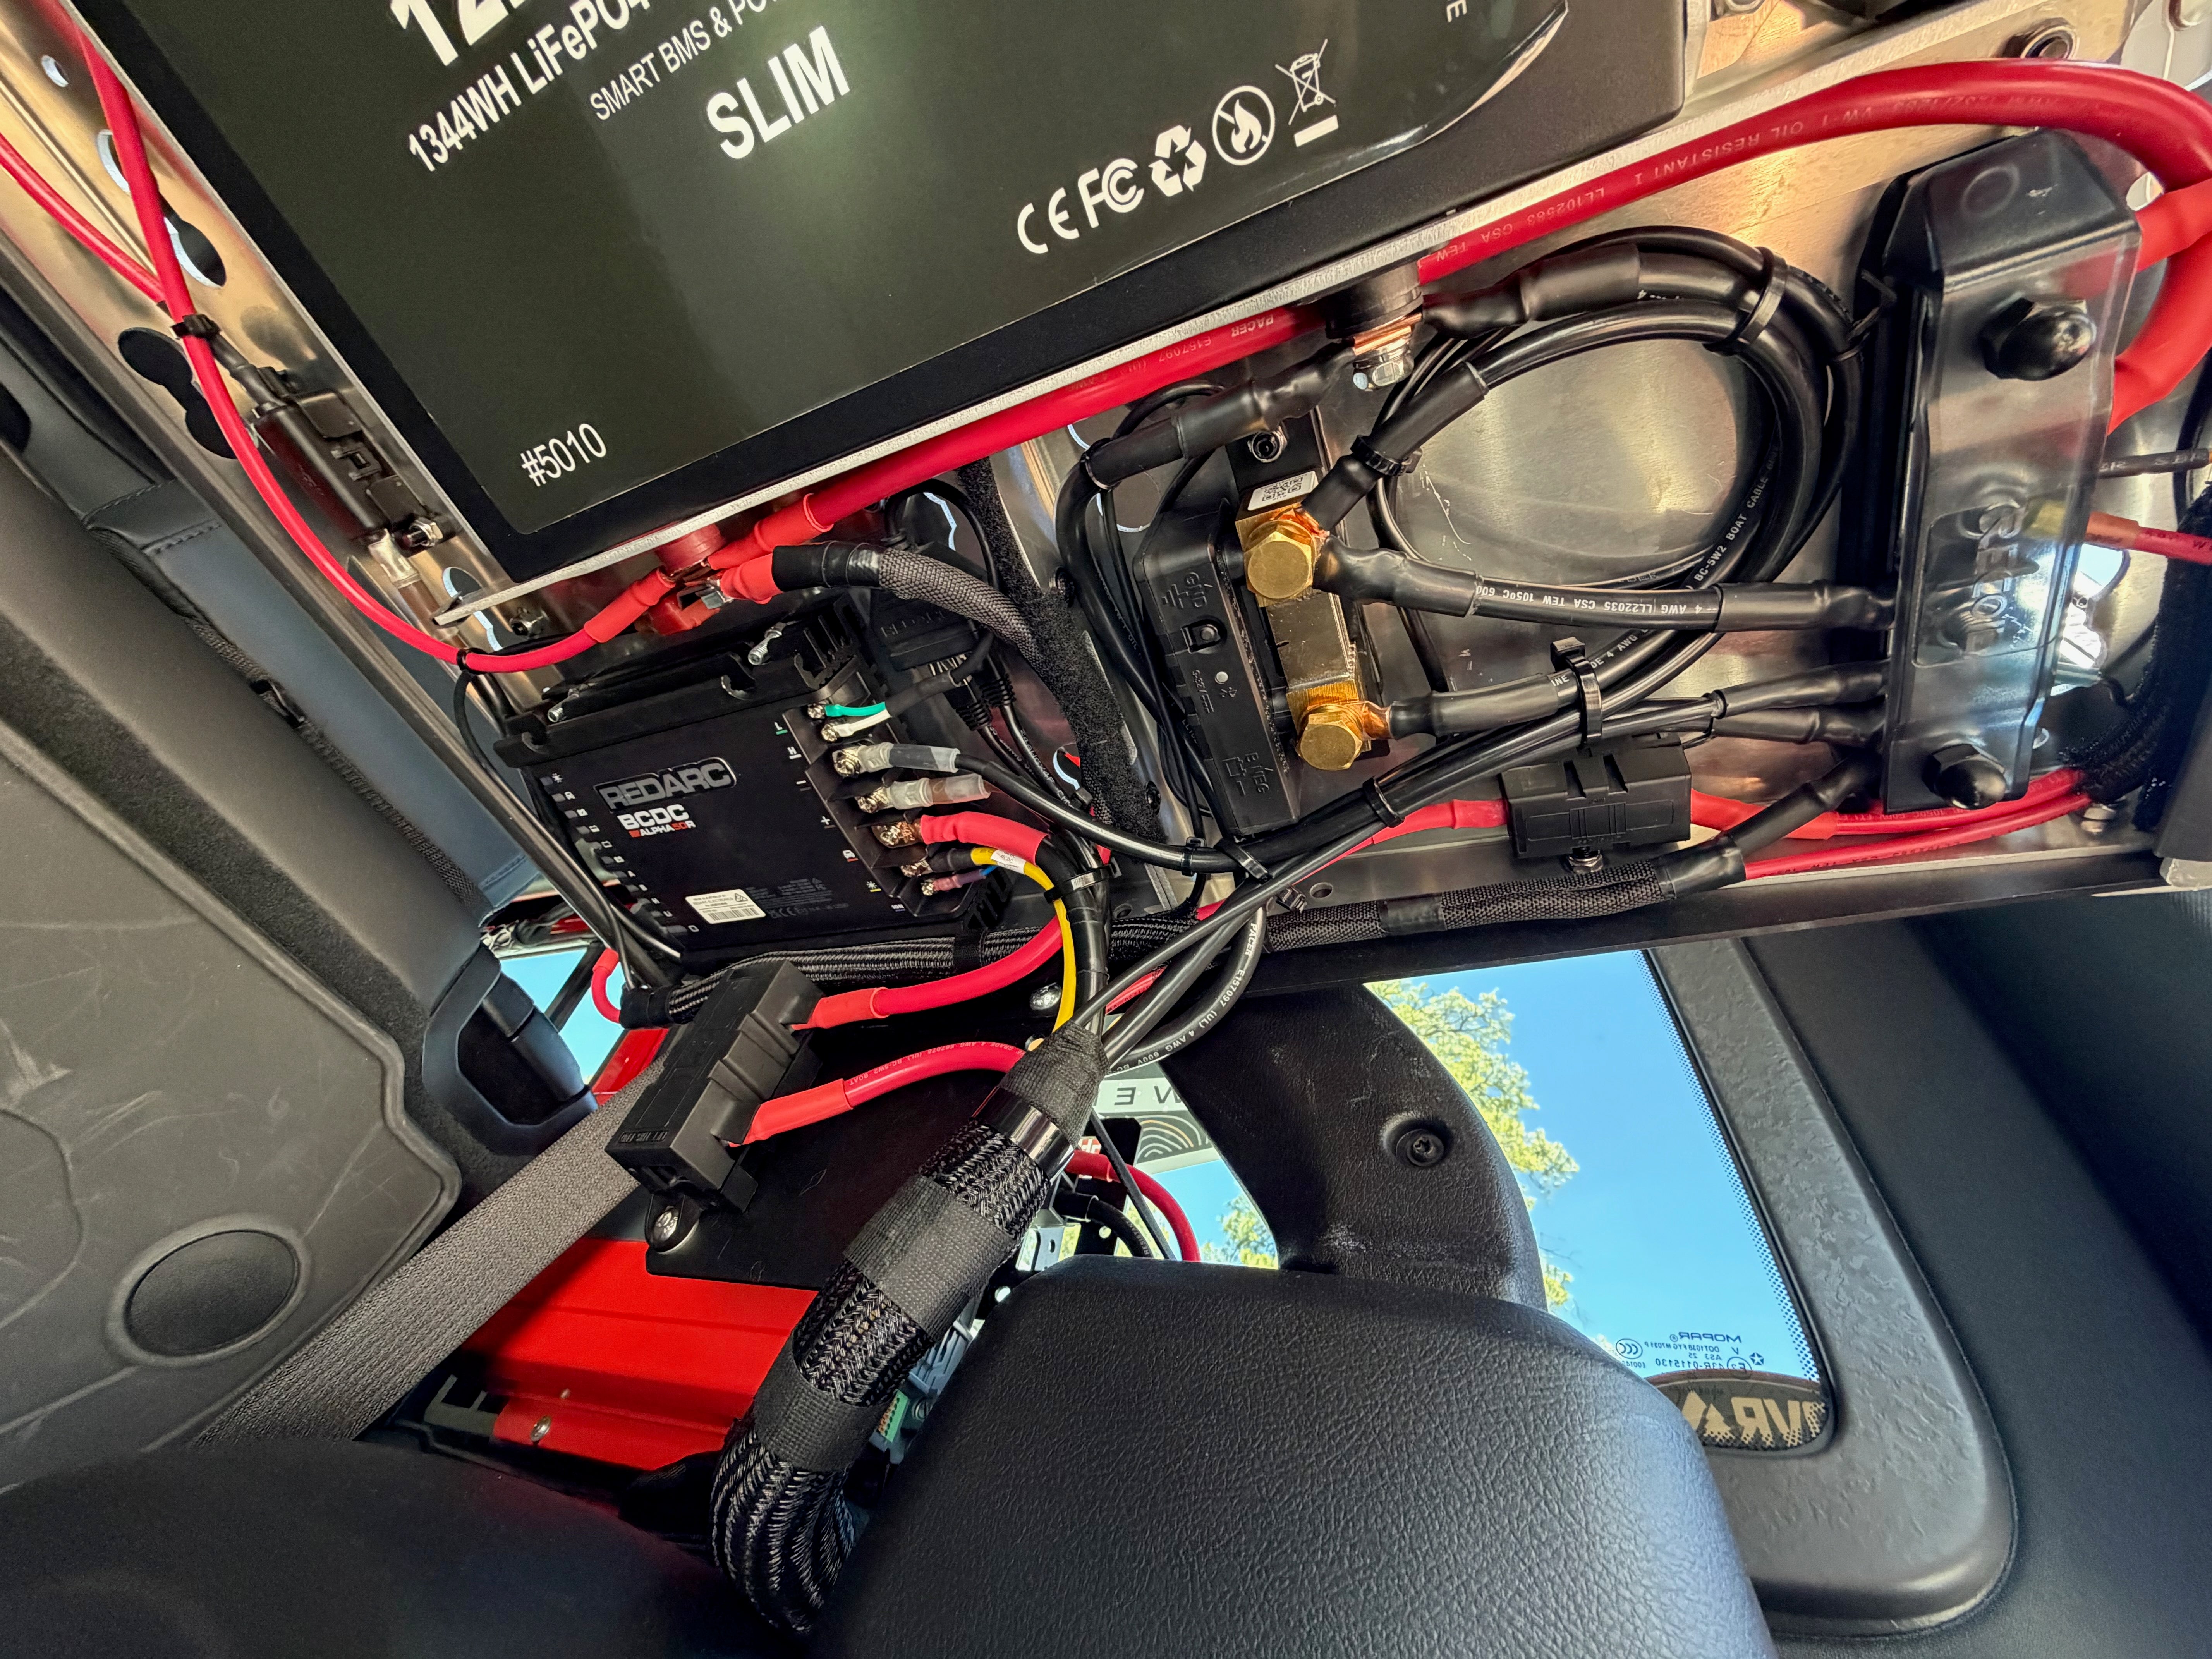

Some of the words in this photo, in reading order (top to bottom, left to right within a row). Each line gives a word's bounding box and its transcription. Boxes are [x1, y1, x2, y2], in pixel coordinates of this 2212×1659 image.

[589, 53, 661, 121] SMART
[658, 20, 711, 74] BMS
[710, 6, 732, 38] &
[706, 25, 851, 161] SLIM
[407, 65, 522, 172] 1344WH
[1770, 120, 1803, 141] OIL
[1653, 132, 1760, 181] RESISTANT
[1230, 314, 1274, 339] PACER
[1159, 335, 1212, 363] E157097
[520, 423, 607, 487] #5010
[1693, 544, 1727, 581] BC-5W2
[1726, 514, 1748, 541] BOAT
[1747, 475, 1769, 508] CABLE
[1542, 595, 1565, 607] TEW
[1574, 598, 1597, 610] CSA
[1604, 600, 1653, 615] LL22035
[1661, 603, 1686, 615] AWG
[1694, 603, 1703, 613] 4
[1605, 649, 1615, 659] 4
[1616, 633, 1638, 652] AWG
[599, 763, 732, 809] REDARC
[617, 804, 689, 831] BCDC
[1245, 923, 1257, 957] PACER
[1219, 969, 1245, 1007] E157097
[1199, 1009, 1217, 1030] (UL)
[1164, 1036, 1188, 1053] AWG
[1187, 1030, 1195, 1039] 4
[1137, 1051, 1160, 1065] 600V
